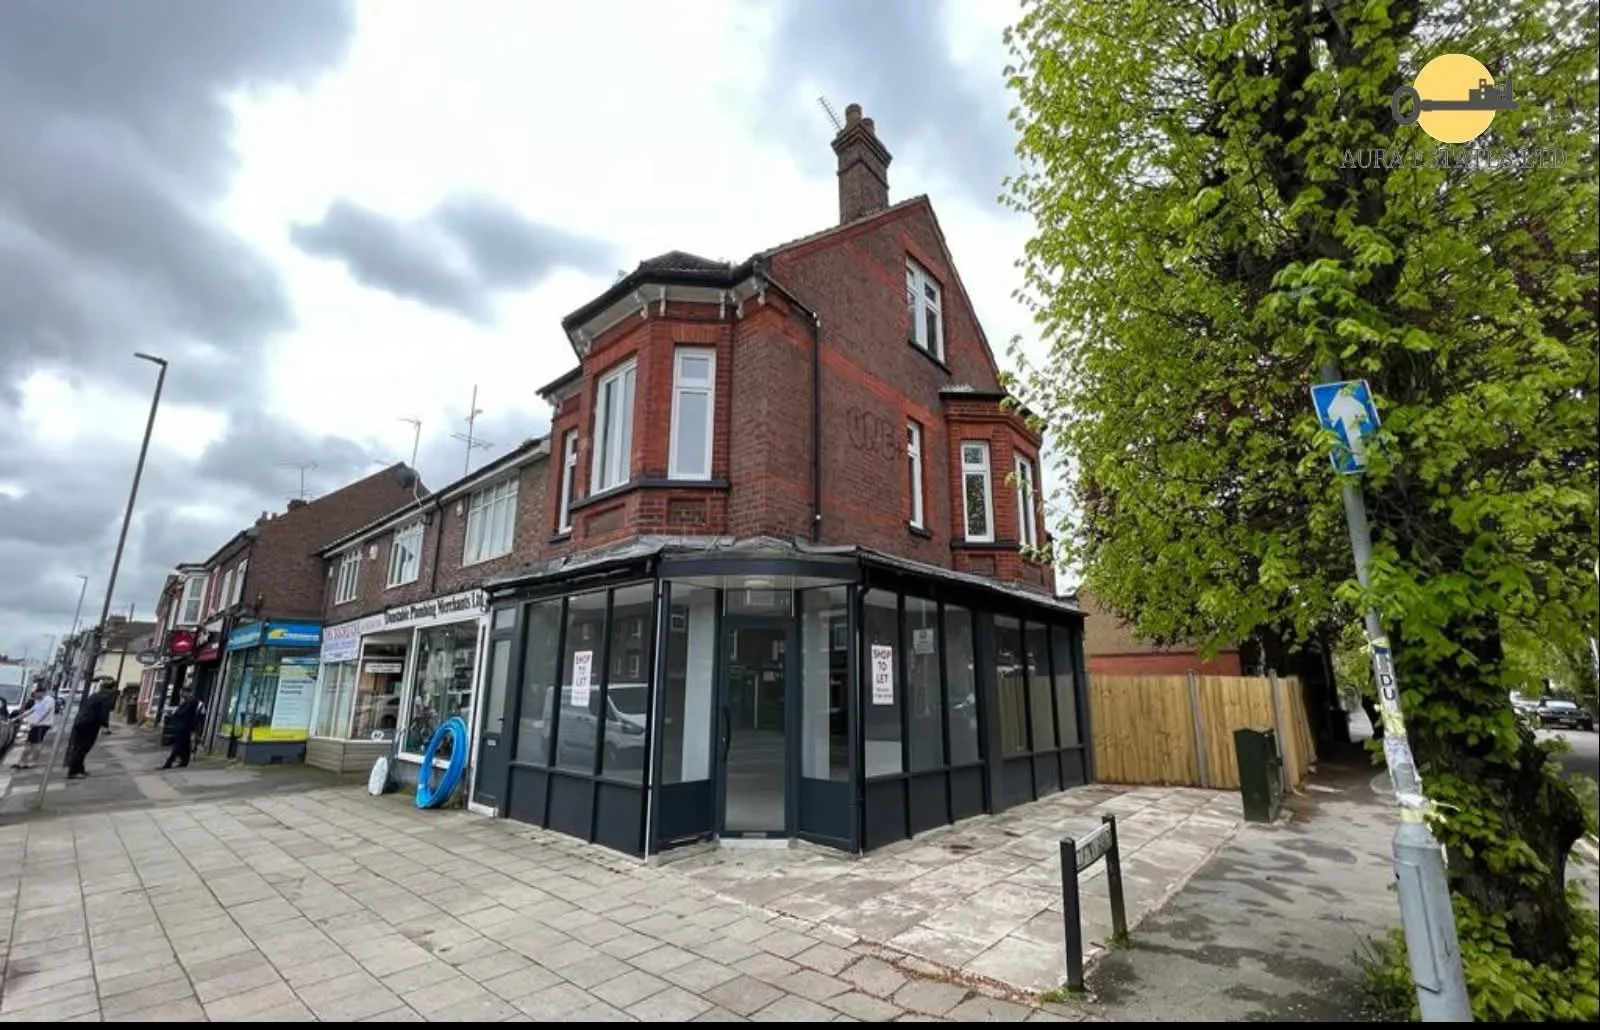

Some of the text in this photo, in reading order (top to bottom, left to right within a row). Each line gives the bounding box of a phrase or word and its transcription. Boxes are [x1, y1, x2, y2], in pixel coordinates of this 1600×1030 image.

[439, 597, 470, 614] Merchants
[873, 648, 891, 659] SHOP
[576, 655, 591, 664] SHOP
[878, 661, 888, 672] TO
[876, 673, 888, 685] LET
